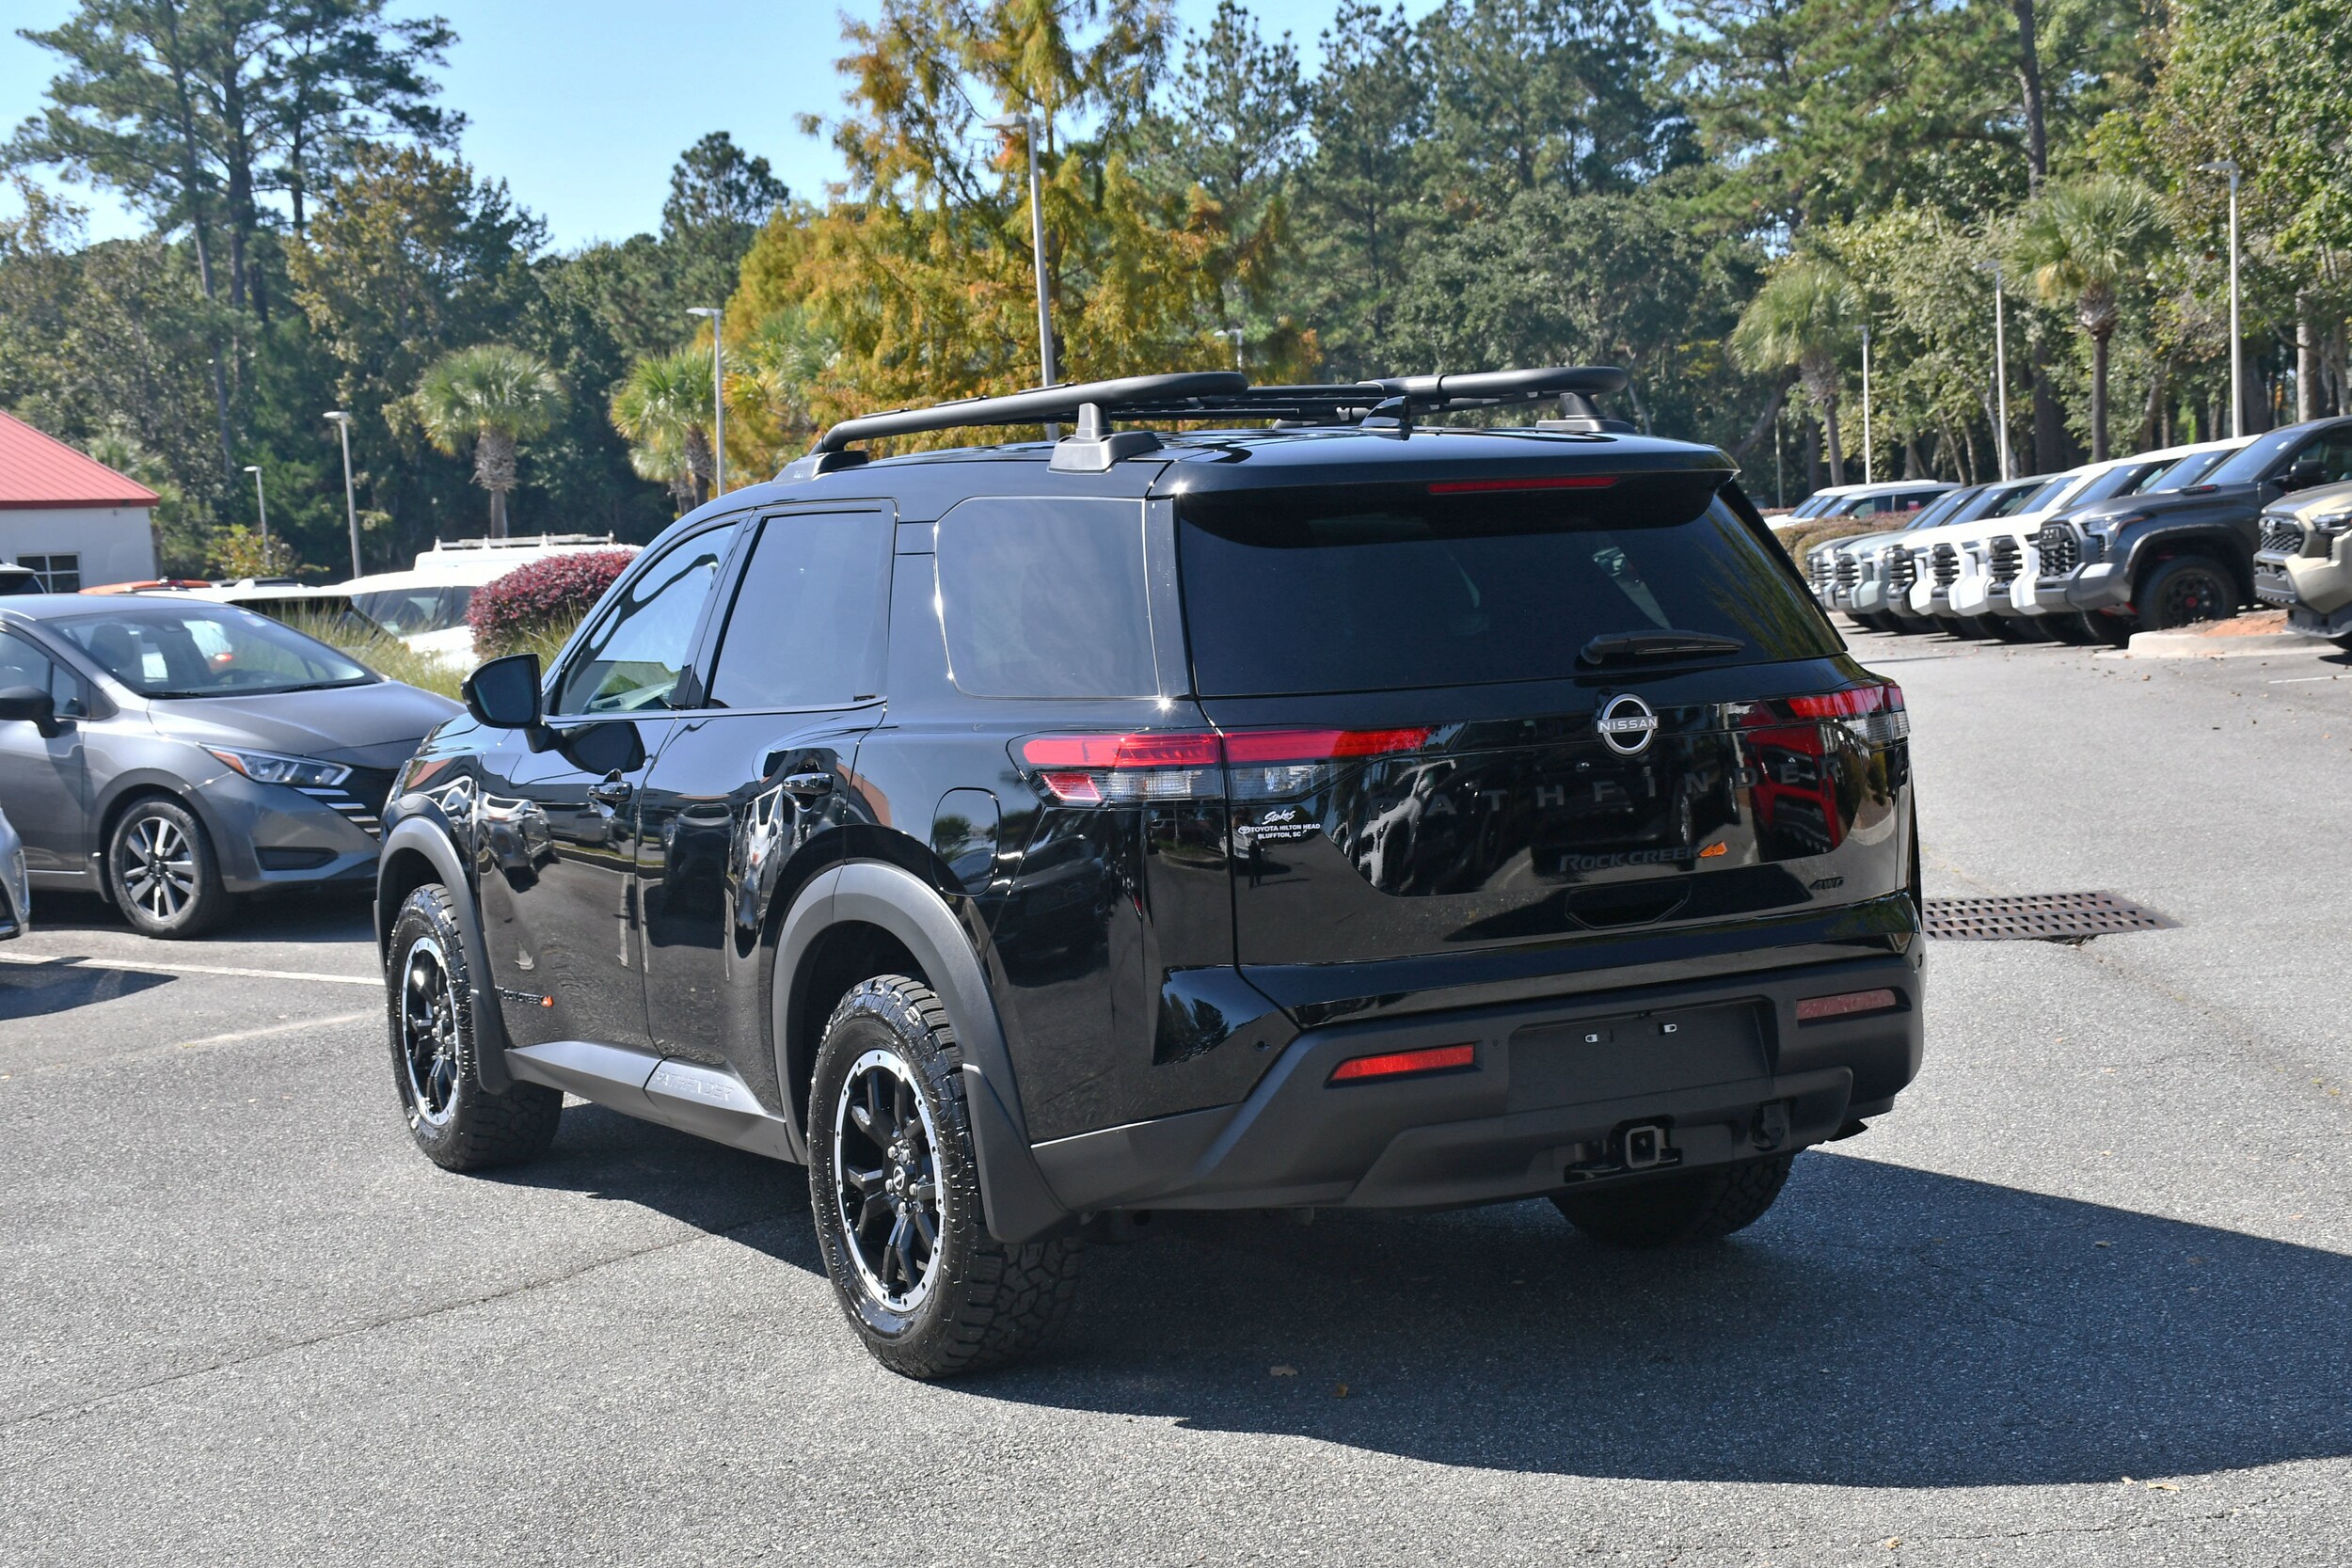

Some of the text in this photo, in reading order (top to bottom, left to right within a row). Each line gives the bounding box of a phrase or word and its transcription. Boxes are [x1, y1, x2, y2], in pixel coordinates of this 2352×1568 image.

[1599, 719, 1657, 731] NISSAN
[1368, 754, 1842, 822] PATHFINDER
[1262, 810, 1295, 825] Stokes
